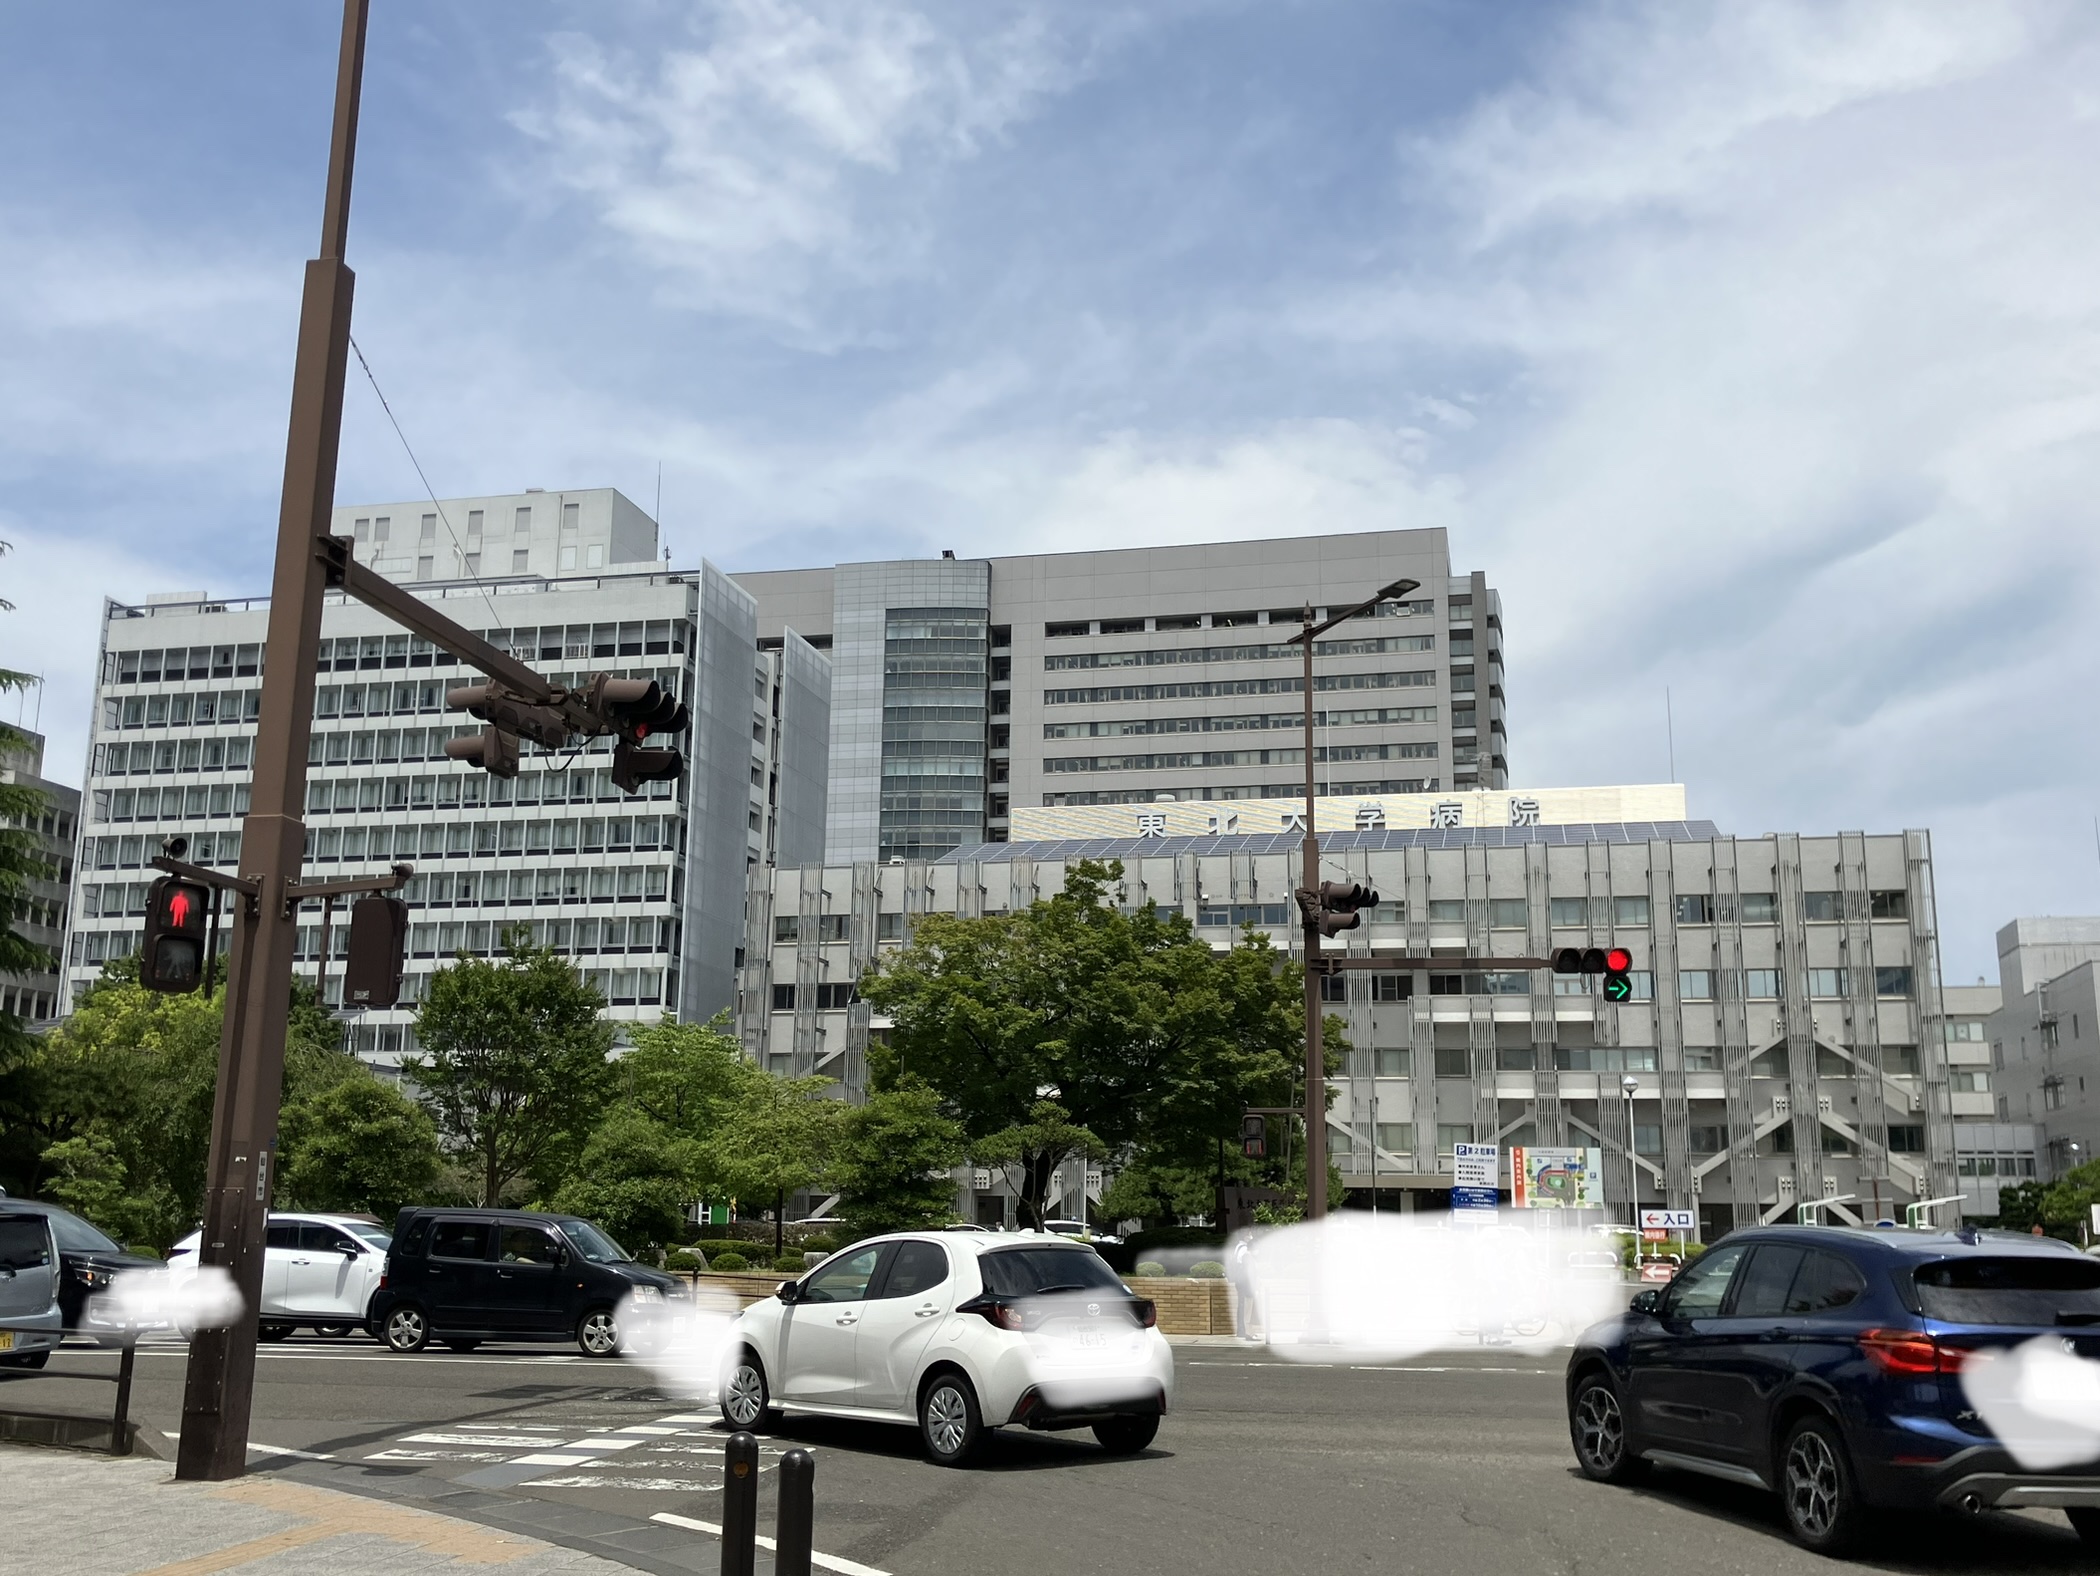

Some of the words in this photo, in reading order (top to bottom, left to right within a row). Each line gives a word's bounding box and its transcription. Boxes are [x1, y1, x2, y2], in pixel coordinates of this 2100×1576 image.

[1136, 795, 1541, 839] 東北大学病院
[1663, 1213, 1690, 1225] 入口
